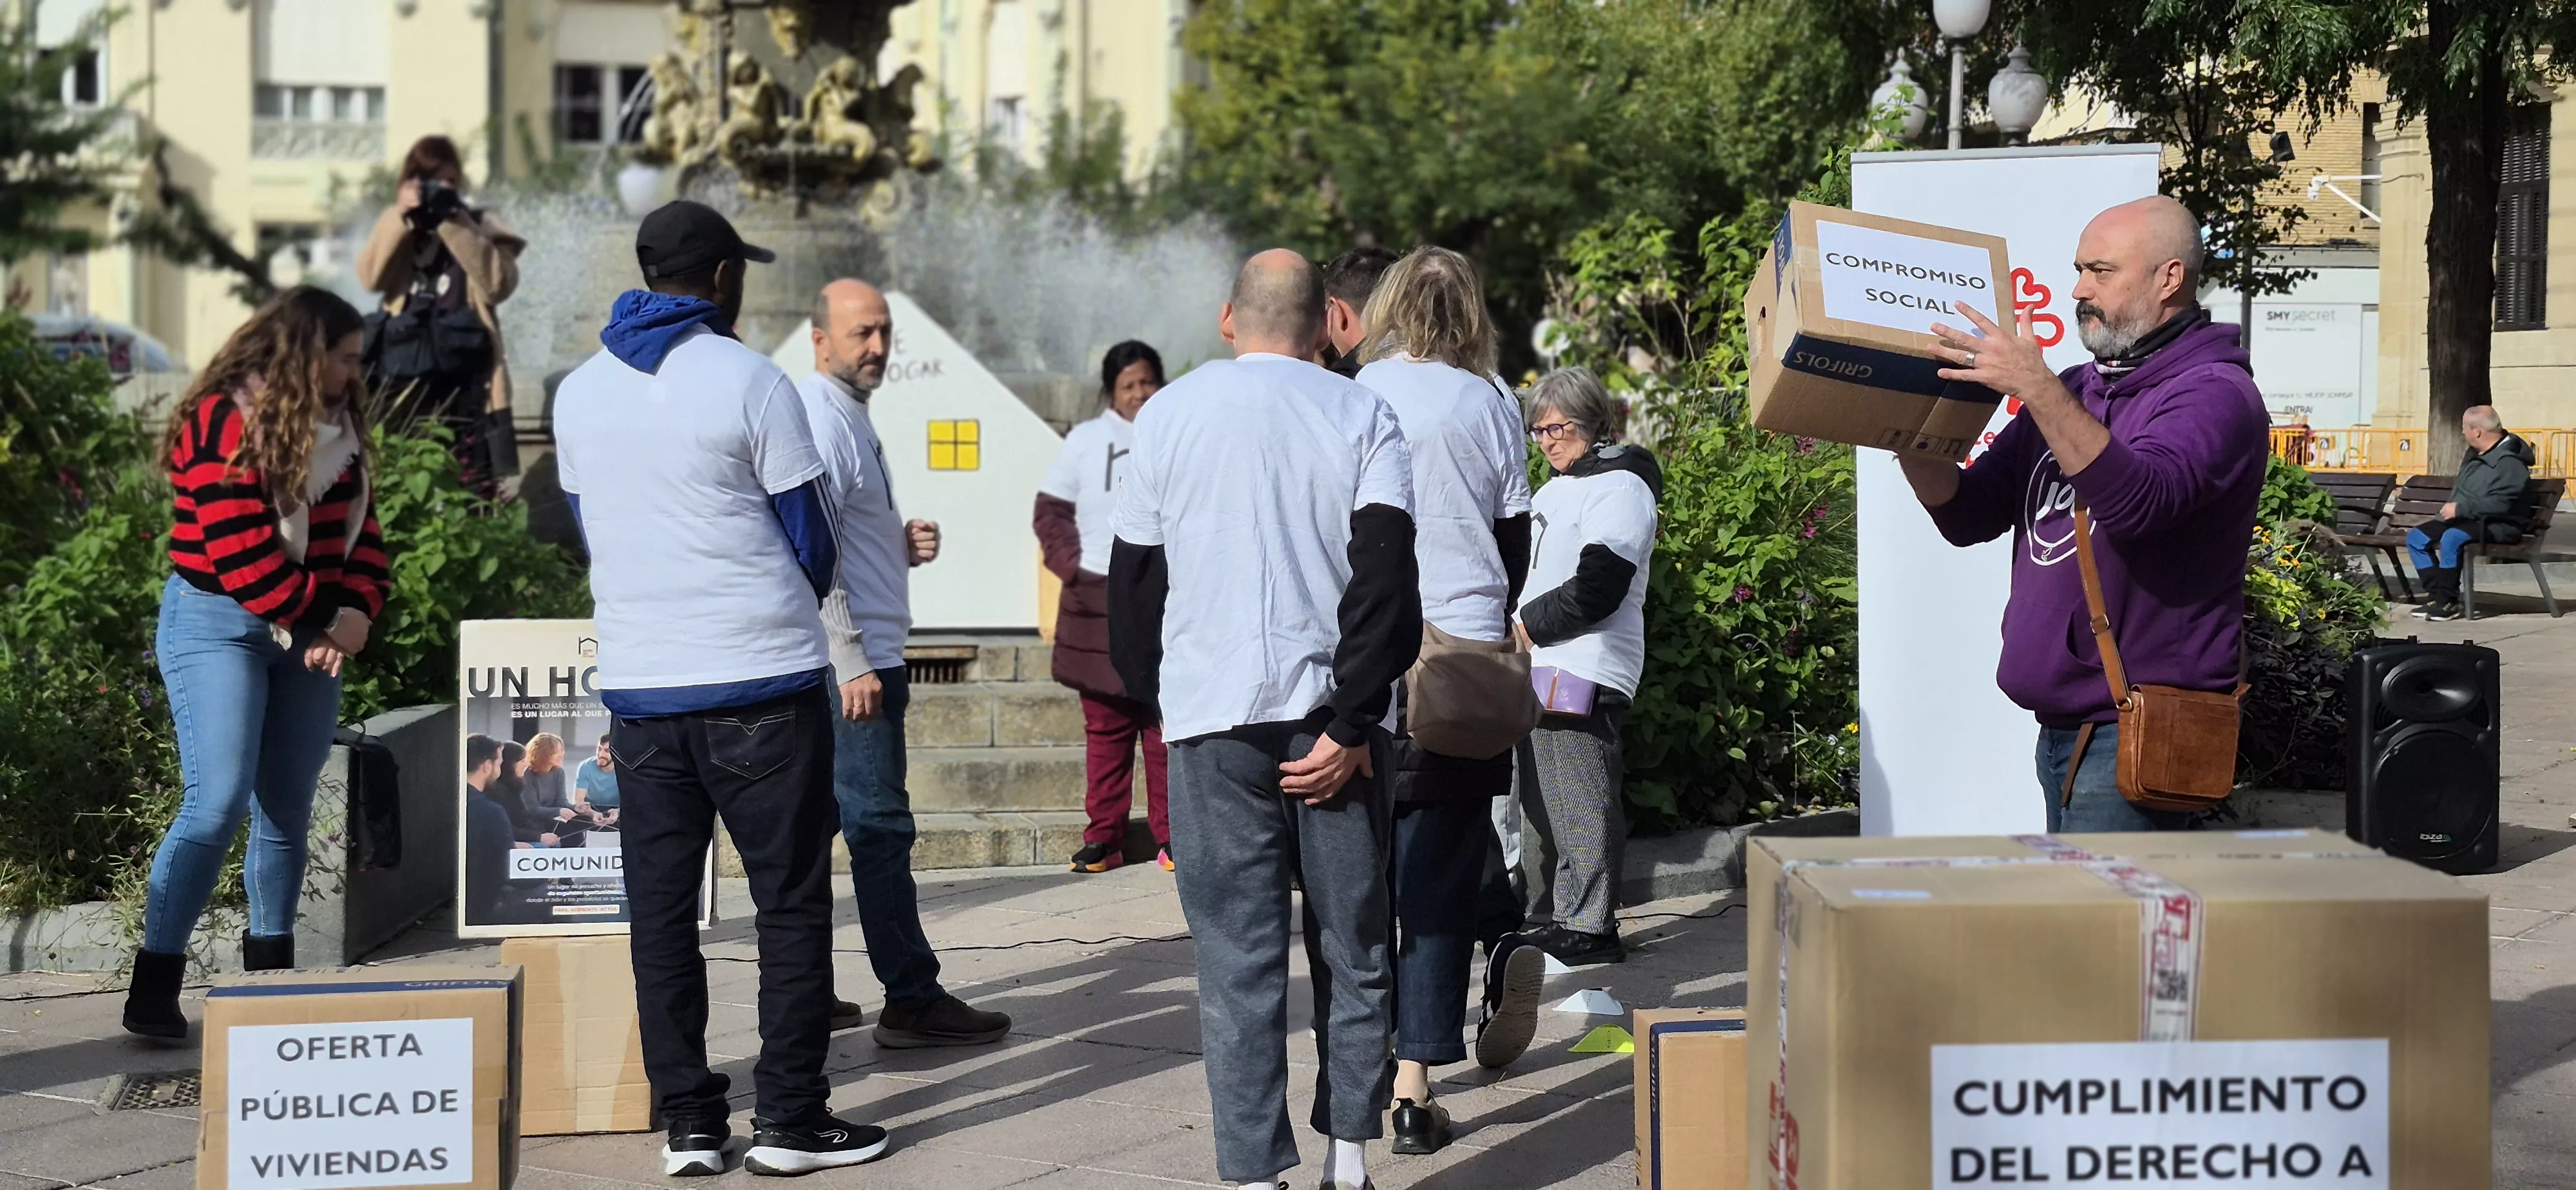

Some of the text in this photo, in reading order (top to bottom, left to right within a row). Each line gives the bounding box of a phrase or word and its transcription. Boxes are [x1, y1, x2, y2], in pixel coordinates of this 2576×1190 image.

[1825, 252, 1986, 289] COMPROMISO
[1865, 288, 1955, 315] SOCIAL
[1793, 351, 1873, 378] GRIFOLS
[468, 666, 529, 697] UN
[277, 1032, 423, 1062] OFERTA
[241, 1089, 458, 1121] PÚBLICA DE
[1954, 1075, 2367, 1116] CUMPLIMIENTO
[251, 1146, 449, 1178] VIVIENDAS
[1951, 1142, 2372, 1182] DEL DERECHO A
